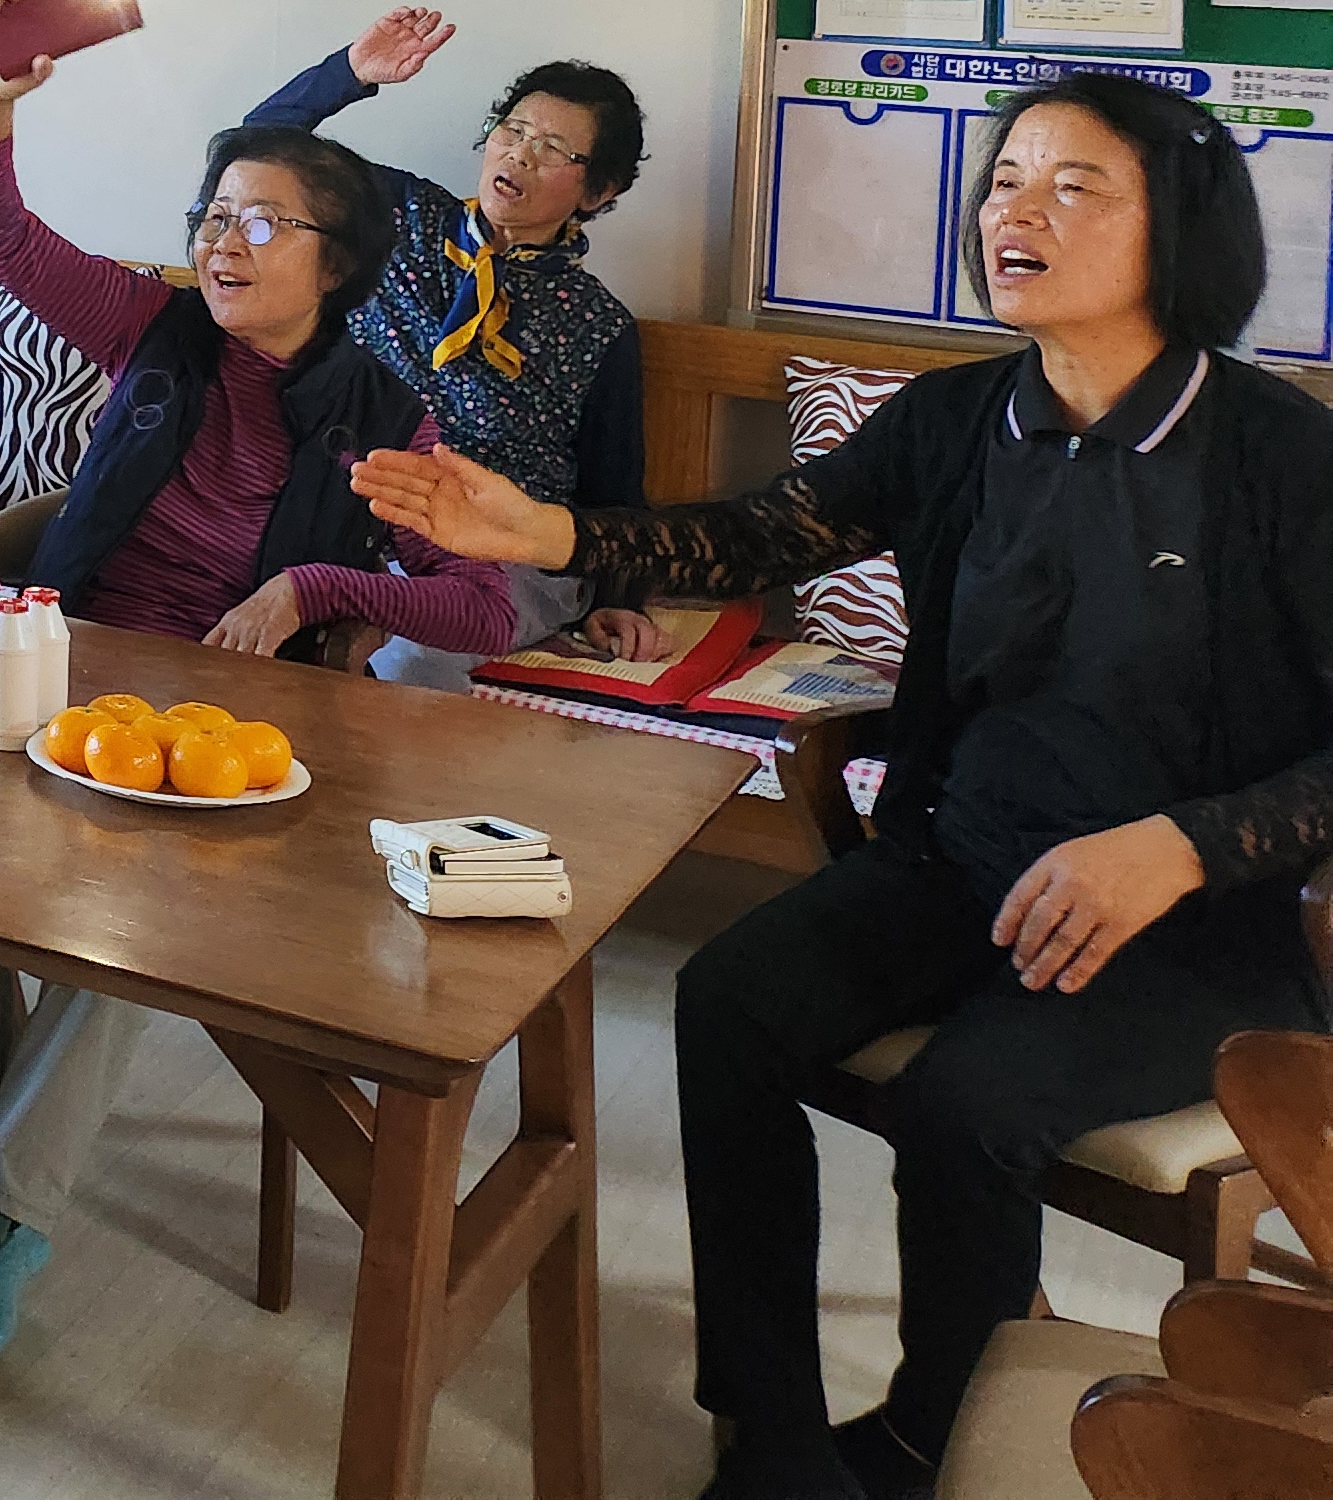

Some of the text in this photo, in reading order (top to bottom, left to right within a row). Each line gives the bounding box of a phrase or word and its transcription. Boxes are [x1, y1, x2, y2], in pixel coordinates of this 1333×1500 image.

[911, 54, 940, 67] 사단
[911, 65, 939, 78] 법인
[816, 80, 918, 99] 경로당 관리카드
